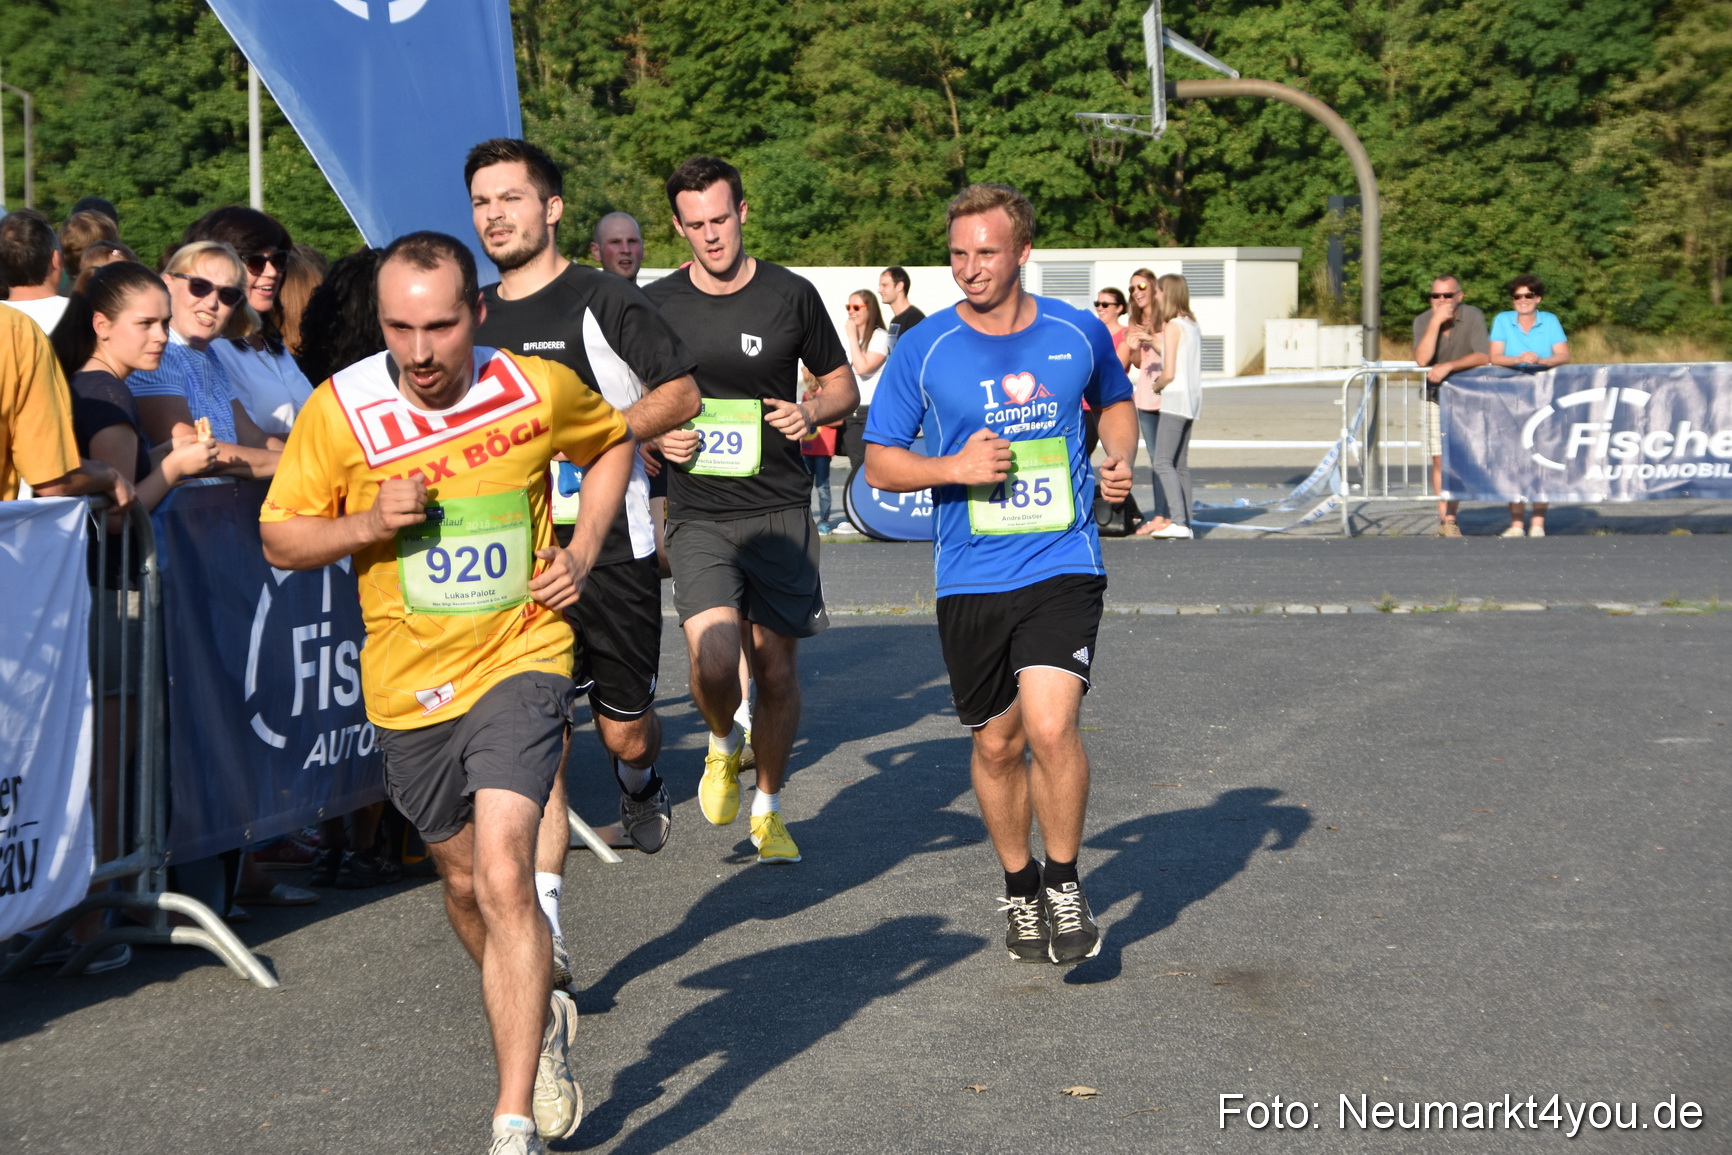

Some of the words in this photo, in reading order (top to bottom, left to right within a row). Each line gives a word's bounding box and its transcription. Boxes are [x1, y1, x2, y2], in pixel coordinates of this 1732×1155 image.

[530, 340, 566, 350] PFLEIDERER
[980, 379, 1000, 410] I
[984, 400, 1058, 424] camping
[1030, 420, 1057, 430] Berger
[461, 417, 550, 469] BÖGL
[1565, 420, 1732, 459] Fische
[1585, 462, 1732, 480] AUTOMOBIL
[988, 477, 1052, 509] 485
[425, 542, 508, 584] 920
[444, 592, 470, 600] Lukas
[470, 588, 496, 598] Palotz
[302, 721, 383, 770] AUTO
